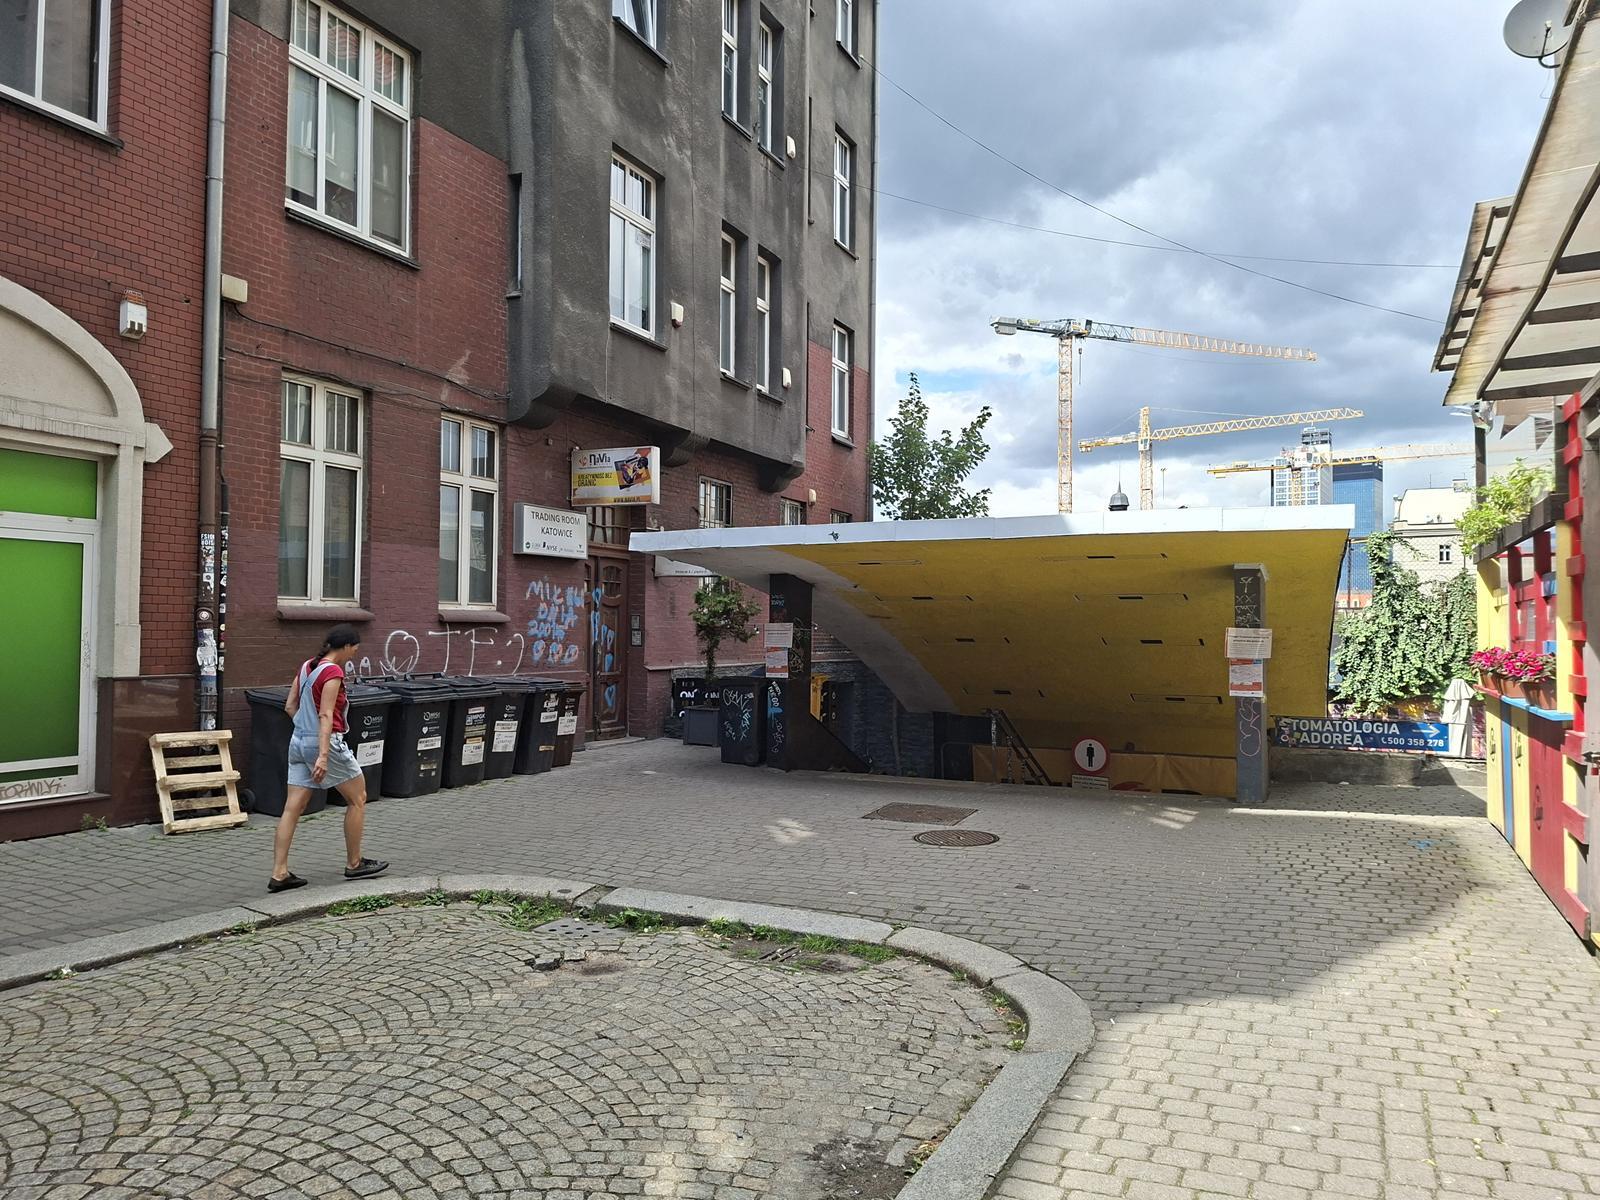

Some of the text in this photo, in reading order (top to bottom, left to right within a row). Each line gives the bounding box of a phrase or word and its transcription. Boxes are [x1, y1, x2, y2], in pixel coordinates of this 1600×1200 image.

[531, 511, 581, 525] TRADING ROOM
[540, 527, 573, 538] KATOWICE
[1283, 719, 1400, 735] TOMATOLOGIA
[1299, 732, 1364, 746] ADOREA
[1387, 737, 1445, 747] 500 358 278
